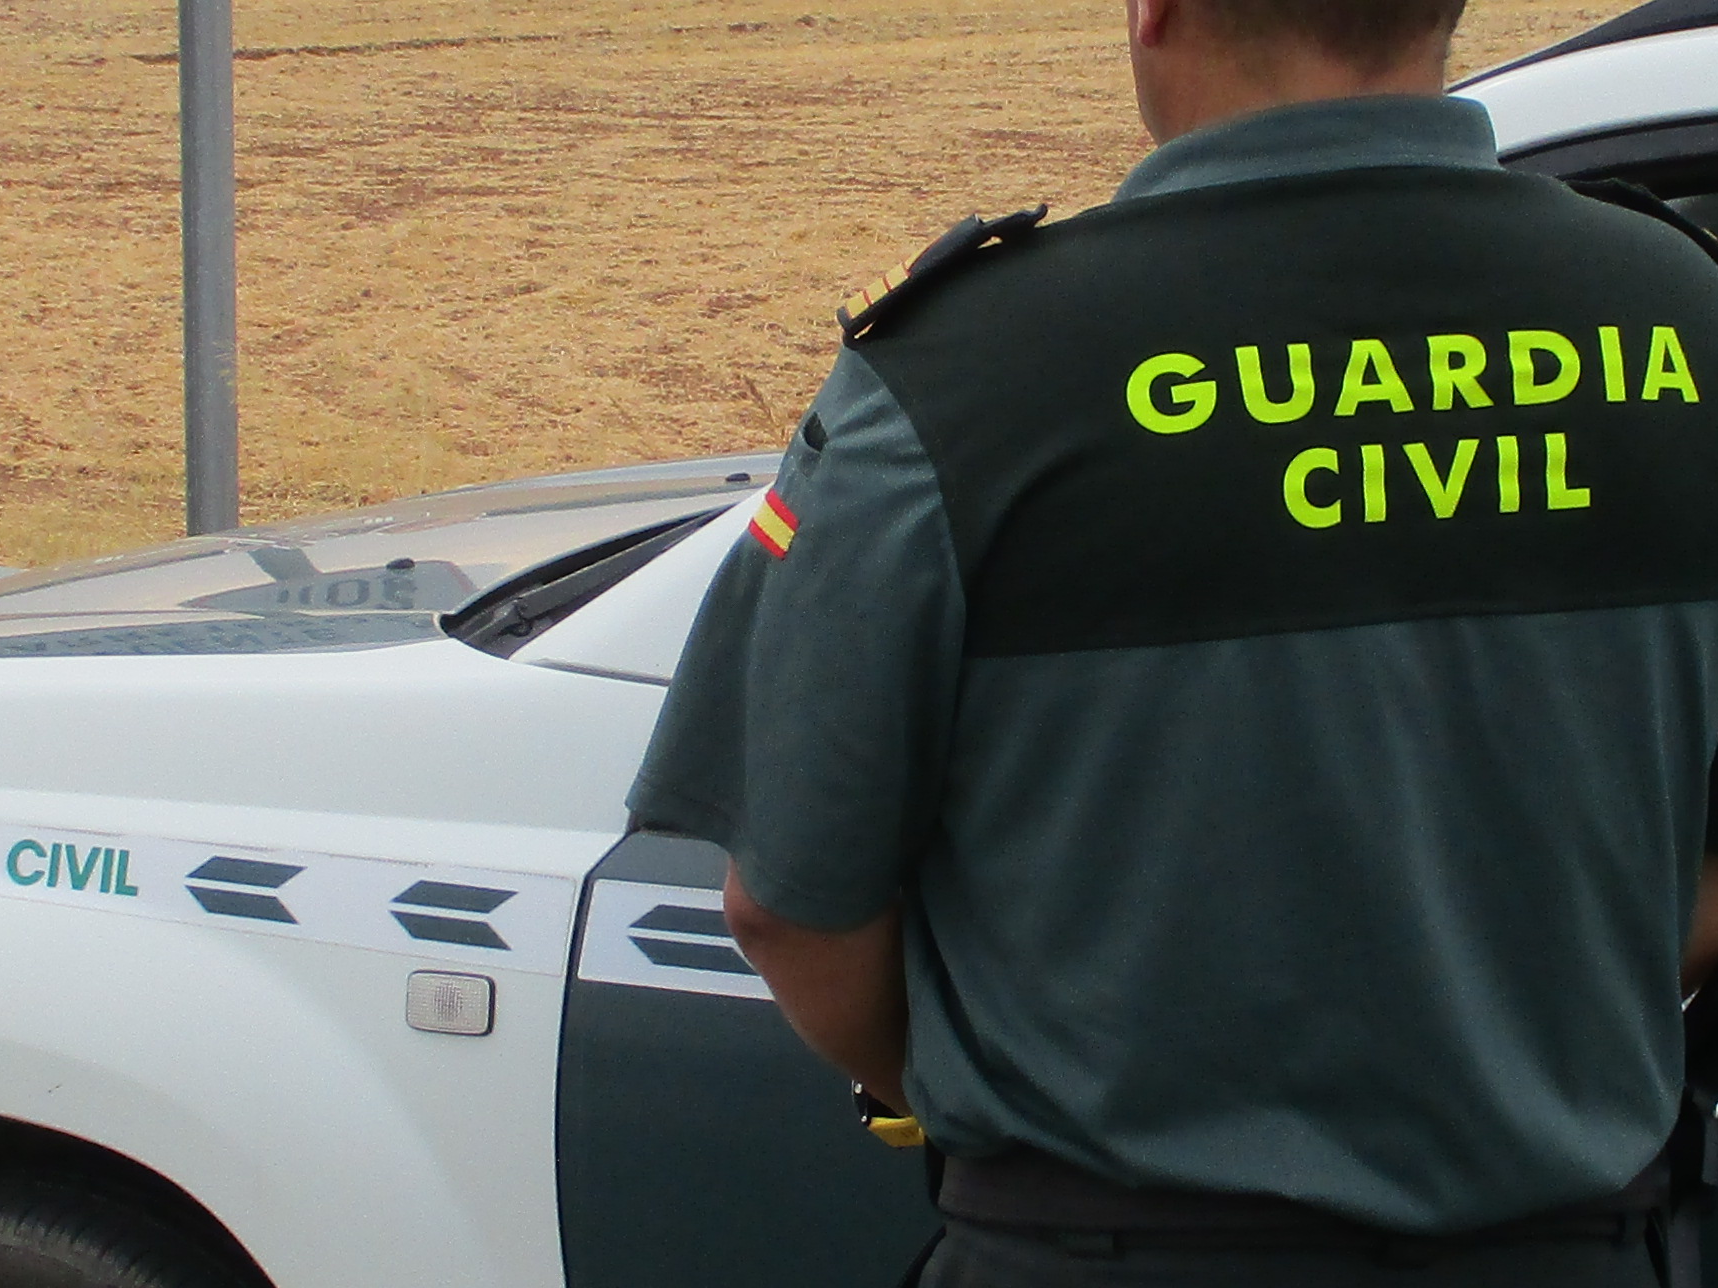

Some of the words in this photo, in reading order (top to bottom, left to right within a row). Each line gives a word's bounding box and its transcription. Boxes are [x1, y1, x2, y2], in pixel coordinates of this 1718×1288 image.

[1126, 326, 1700, 434] GUARDIA
[1283, 433, 1591, 529] CIVIL
[7, 839, 139, 896] CIVIL
